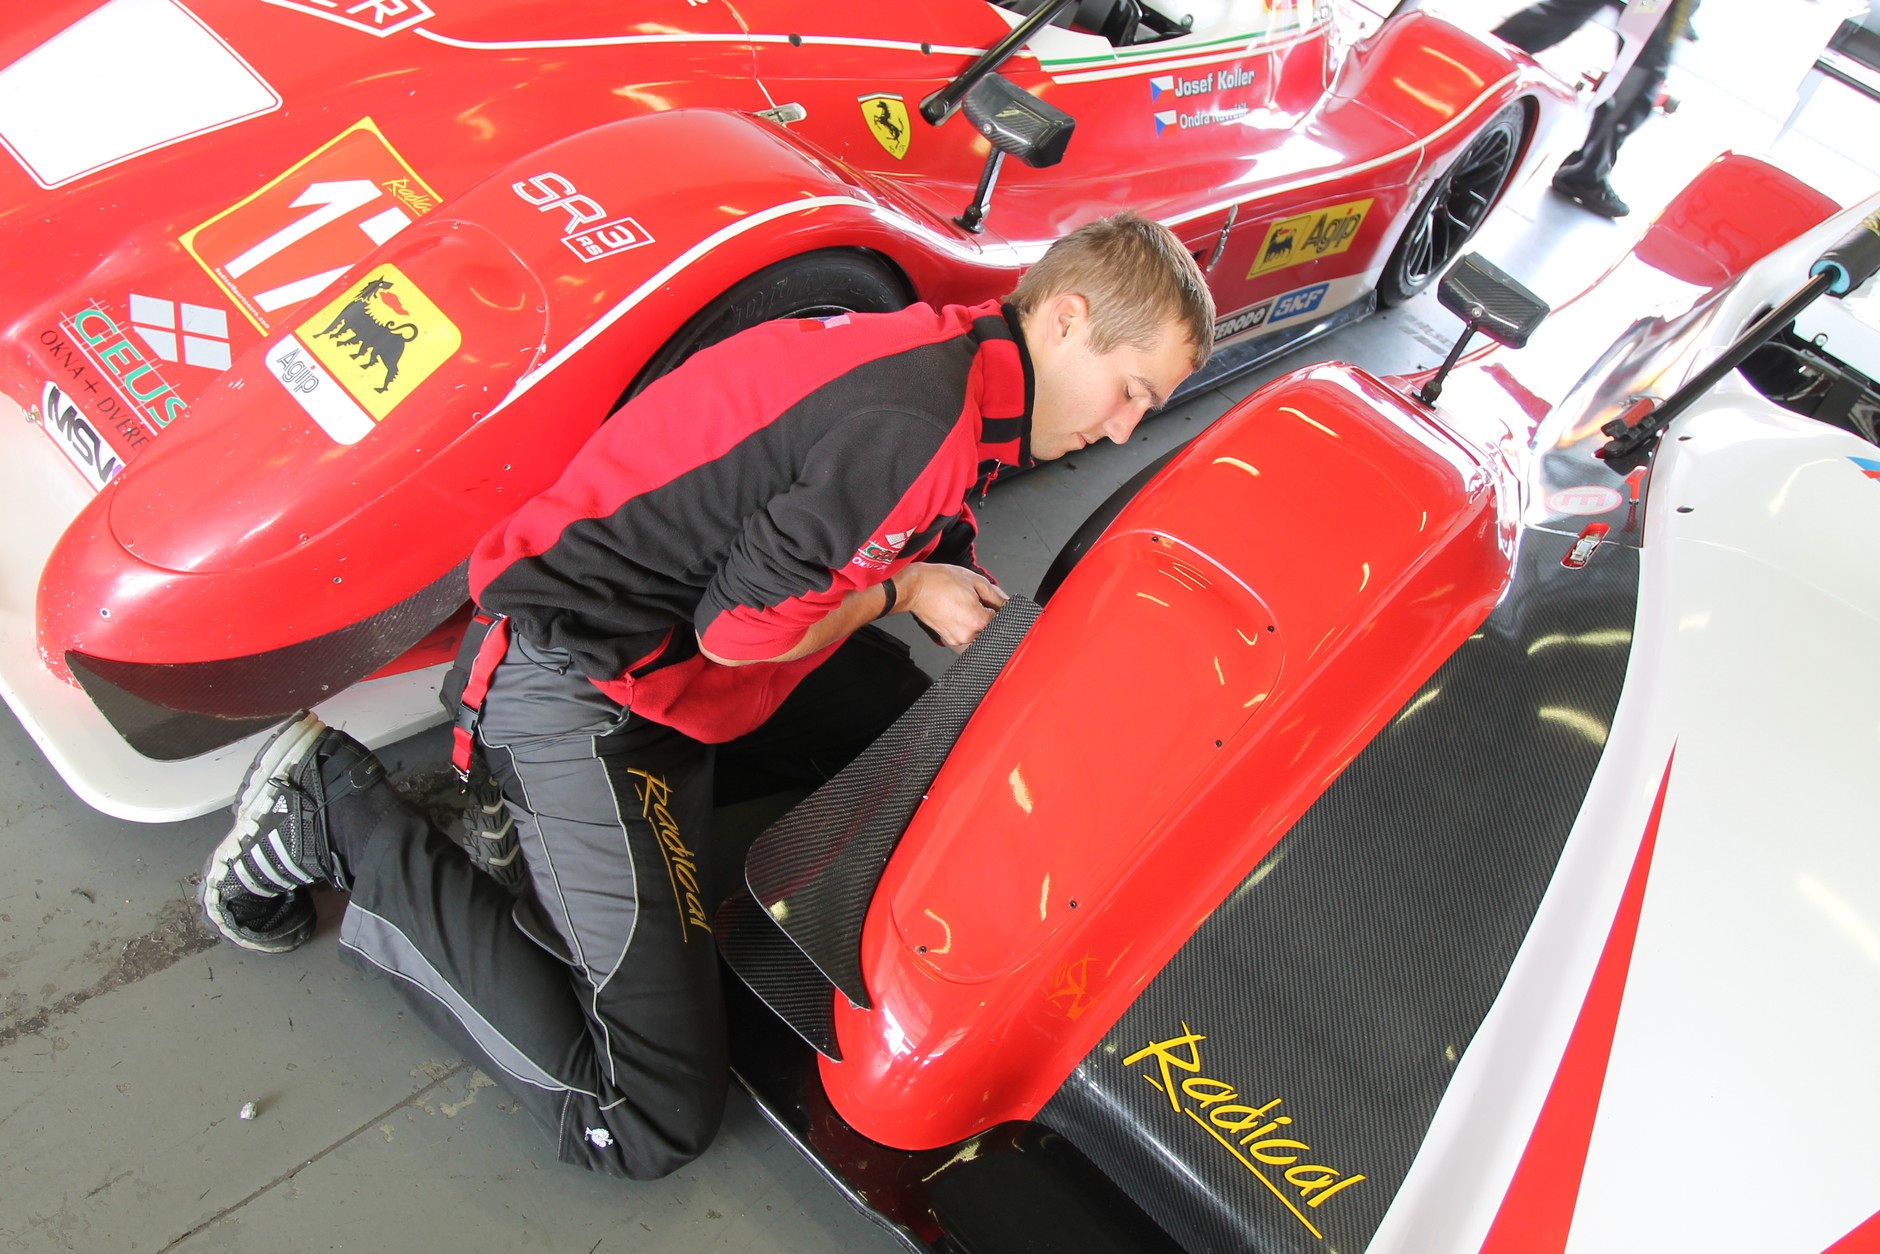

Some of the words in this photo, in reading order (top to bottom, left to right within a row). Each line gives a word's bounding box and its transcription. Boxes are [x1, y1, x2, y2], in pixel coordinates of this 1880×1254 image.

[1174, 72, 1214, 98] Josef
[1217, 67, 1255, 91] Koller
[575, 235, 604, 256] RS
[1300, 207, 1362, 254] Agip
[1274, 287, 1325, 318] SKF
[40, 329, 87, 380] OKNA
[73, 308, 188, 429] GEUS
[275, 347, 320, 394] Agip
[626, 767, 713, 940] Radical
[1122, 1019, 1367, 1216] Radical
